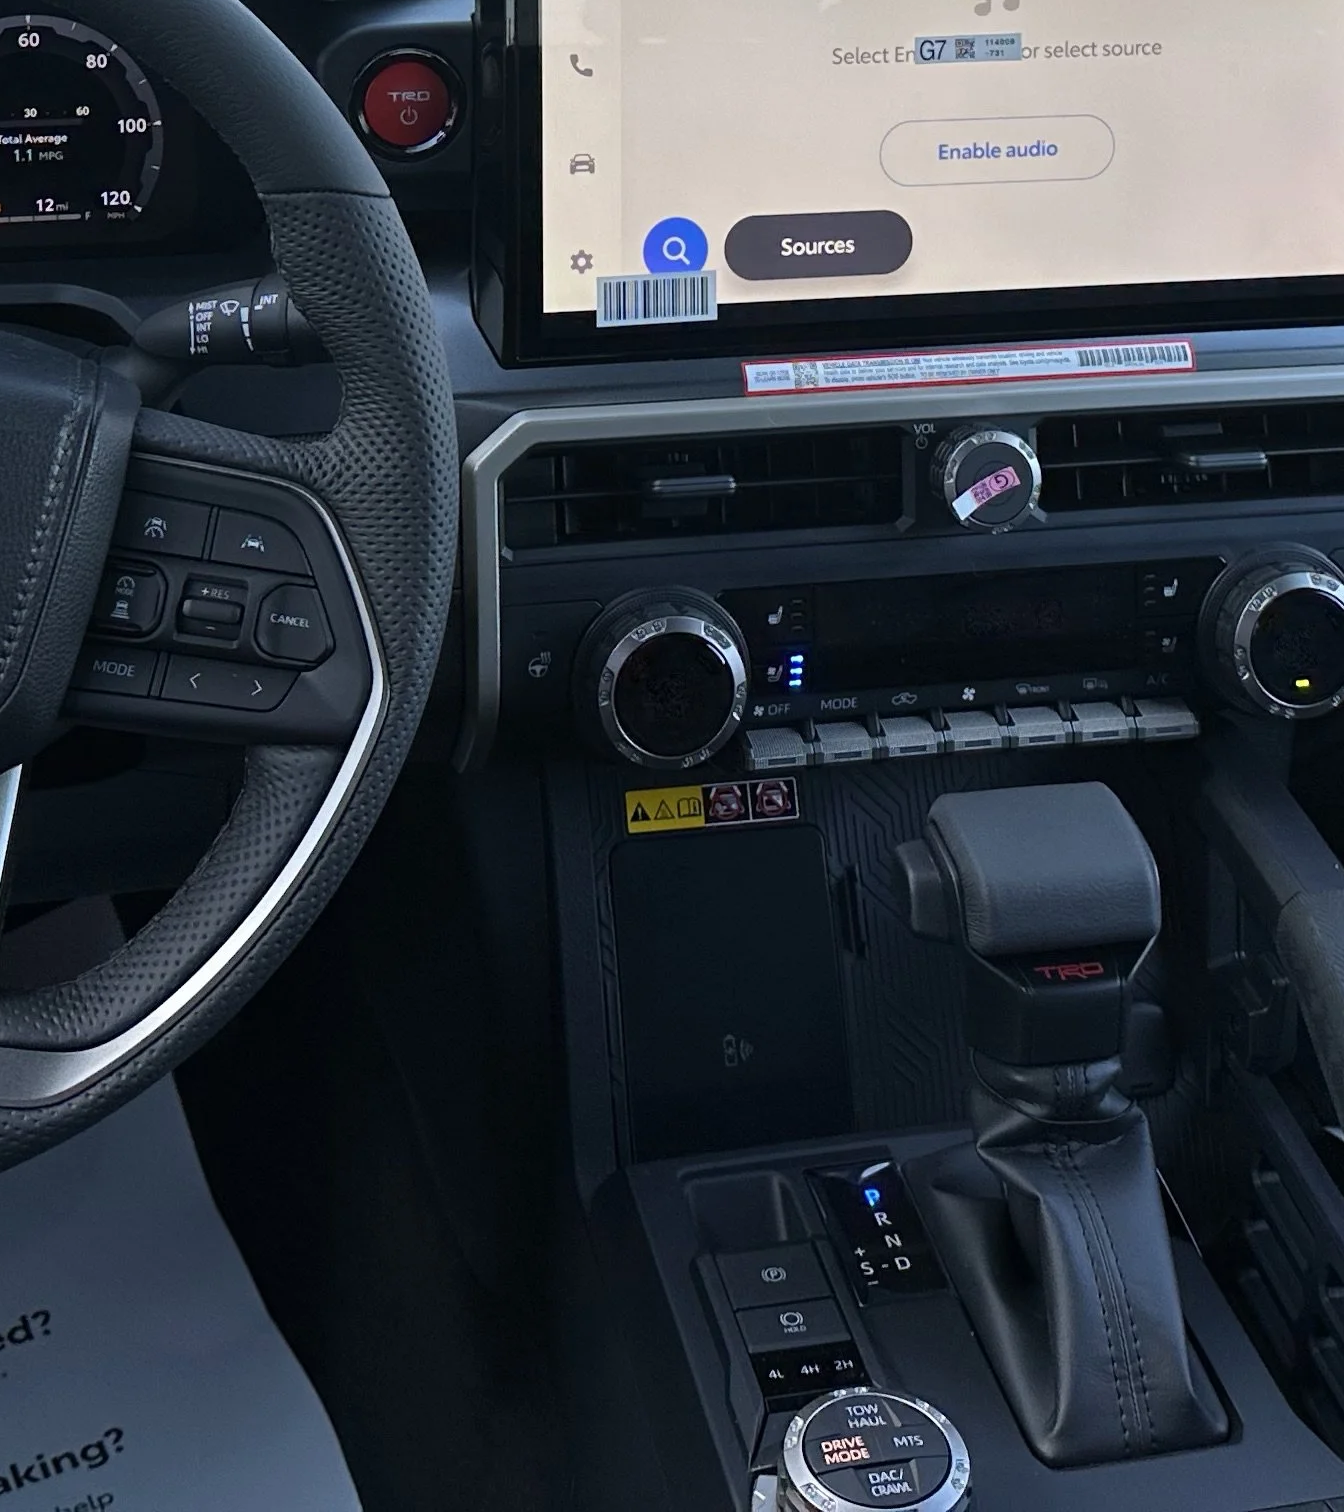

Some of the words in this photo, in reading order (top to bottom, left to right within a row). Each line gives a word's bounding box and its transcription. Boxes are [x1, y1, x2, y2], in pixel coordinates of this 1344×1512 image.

[18, 32, 40, 48] 60
[832, 46, 889, 65] Select
[919, 39, 948, 62] G7
[1021, 46, 1040, 60] or
[1044, 40, 1099, 59] select
[1102, 40, 1163, 57] source
[85, 53, 107, 69] 80
[387, 90, 431, 103] TRD
[23, 107, 37, 118] 30
[76, 105, 90, 116] 60
[117, 118, 147, 134] 100
[25, 133, 68, 146] Average
[14, 149, 33, 162] 1.1
[38, 151, 64, 161] MPG
[937, 141, 1002, 161] Enable
[1006, 140, 1059, 158] audio
[100, 190, 130, 206] 120
[780, 237, 856, 257] Sources
[195, 300, 218, 311] MIST
[259, 293, 278, 305] INT
[195, 312, 214, 322] OFF
[196, 322, 212, 332] INT
[196, 334, 209, 343] LO
[913, 423, 936, 434] VOL
[269, 612, 310, 629] CANCEL
[93, 659, 136, 678] MODE
[1145, 672, 1169, 686] A/C
[767, 702, 791, 716] OFF
[820, 697, 858, 711] MODE
[1034, 962, 1105, 980] TRD
[864, 1189, 881, 1207] P
[873, 1211, 893, 1227] R
[884, 1233, 903, 1248] N
[860, 1261, 875, 1276] S
[894, 1256, 911, 1271] D
[768, 1368, 785, 1379] 4L
[800, 1363, 821, 1375] 4H
[833, 1359, 854, 1370] 2H
[845, 1403, 879, 1417] TOW
[847, 1415, 887, 1429] HAUL
[820, 1435, 865, 1453] DRIVE
[892, 1435, 924, 1448] MTS
[824, 1447, 871, 1465] MODE
[868, 1468, 905, 1485] DAC/
[871, 1481, 913, 1497] CRAWL
